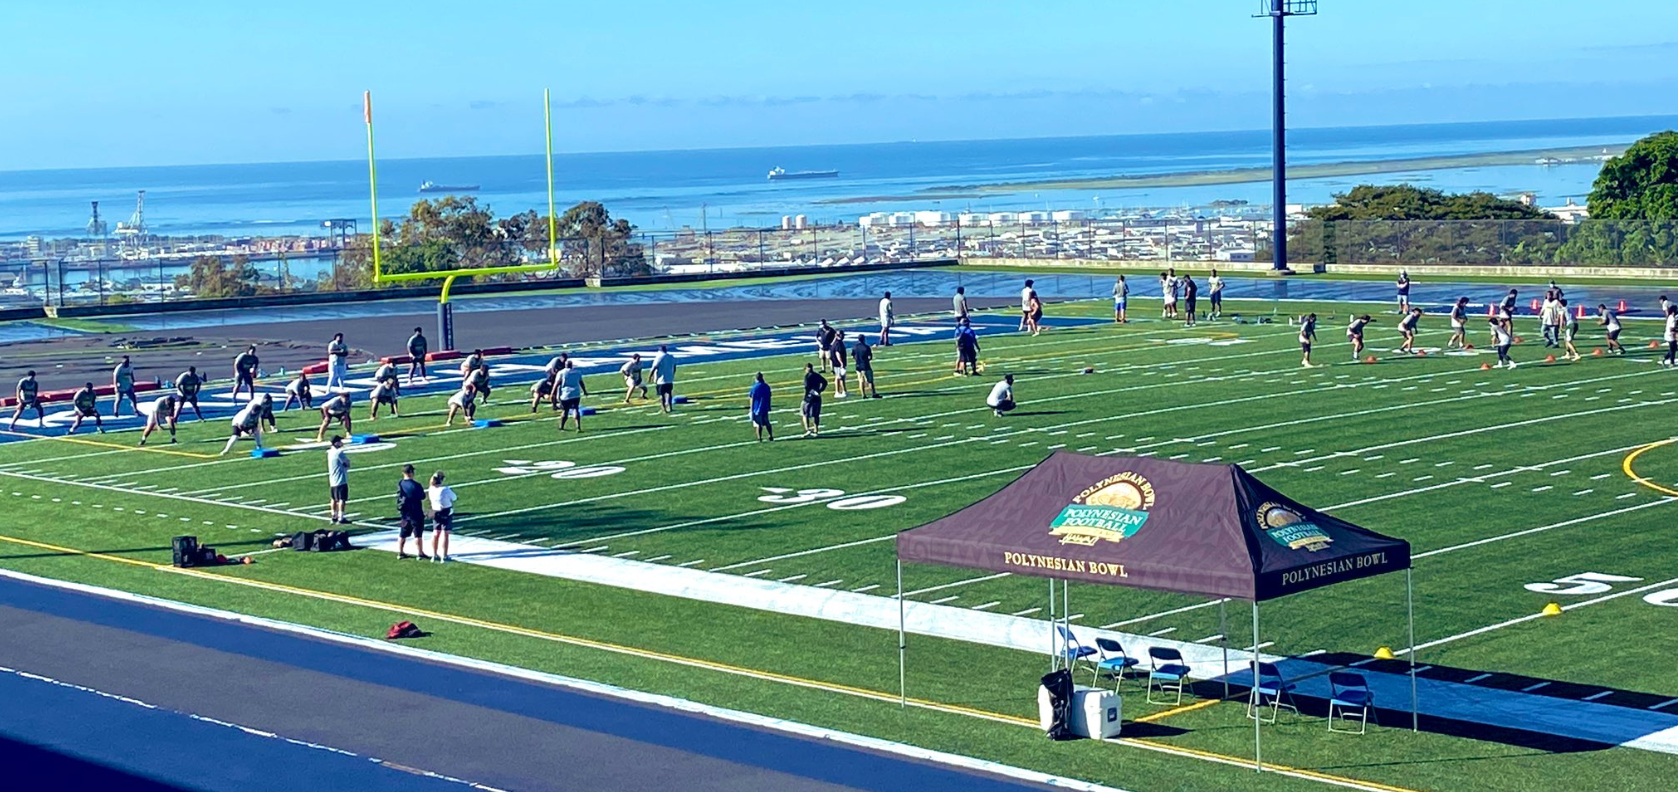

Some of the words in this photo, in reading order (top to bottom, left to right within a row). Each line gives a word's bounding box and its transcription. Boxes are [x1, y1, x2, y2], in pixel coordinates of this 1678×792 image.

[491, 460, 626, 479] 20
[757, 488, 907, 510] 30
[1072, 471, 1144, 503] POLYNESIAN
[1141, 482, 1156, 510] BOWL
[1062, 517, 1127, 532] FOOTBALL
[1063, 508, 1143, 526] POLYNESIAN
[1004, 551, 1086, 573] POLYNESIAN
[1089, 561, 1128, 578] BOWL
[1282, 558, 1354, 586] POLYNESIAN
[1356, 551, 1388, 569] BOWL
